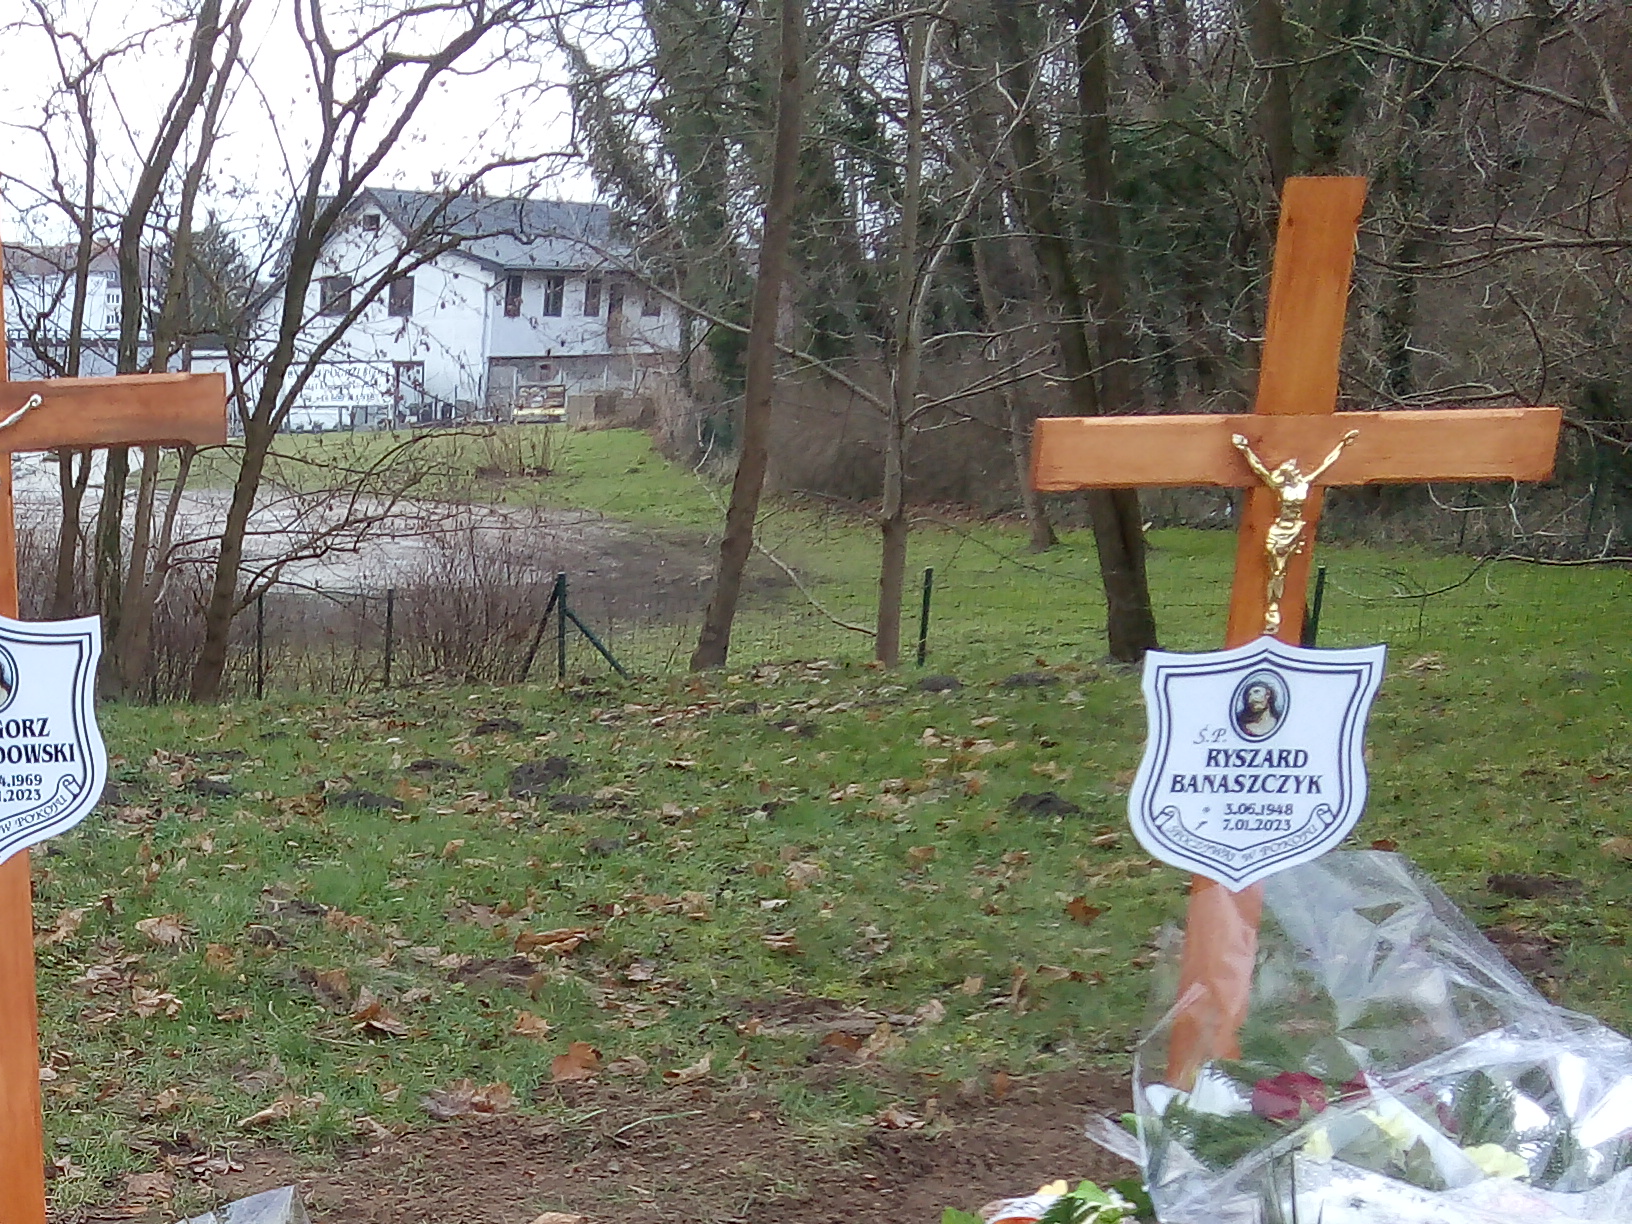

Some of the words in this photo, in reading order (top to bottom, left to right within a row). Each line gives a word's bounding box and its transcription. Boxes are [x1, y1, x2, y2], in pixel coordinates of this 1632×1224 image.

[1205, 748, 1309, 769] RYSZARD
[1170, 774, 1323, 794] BANASZCZYK
[1222, 818, 1292, 832] 7.01.2023
